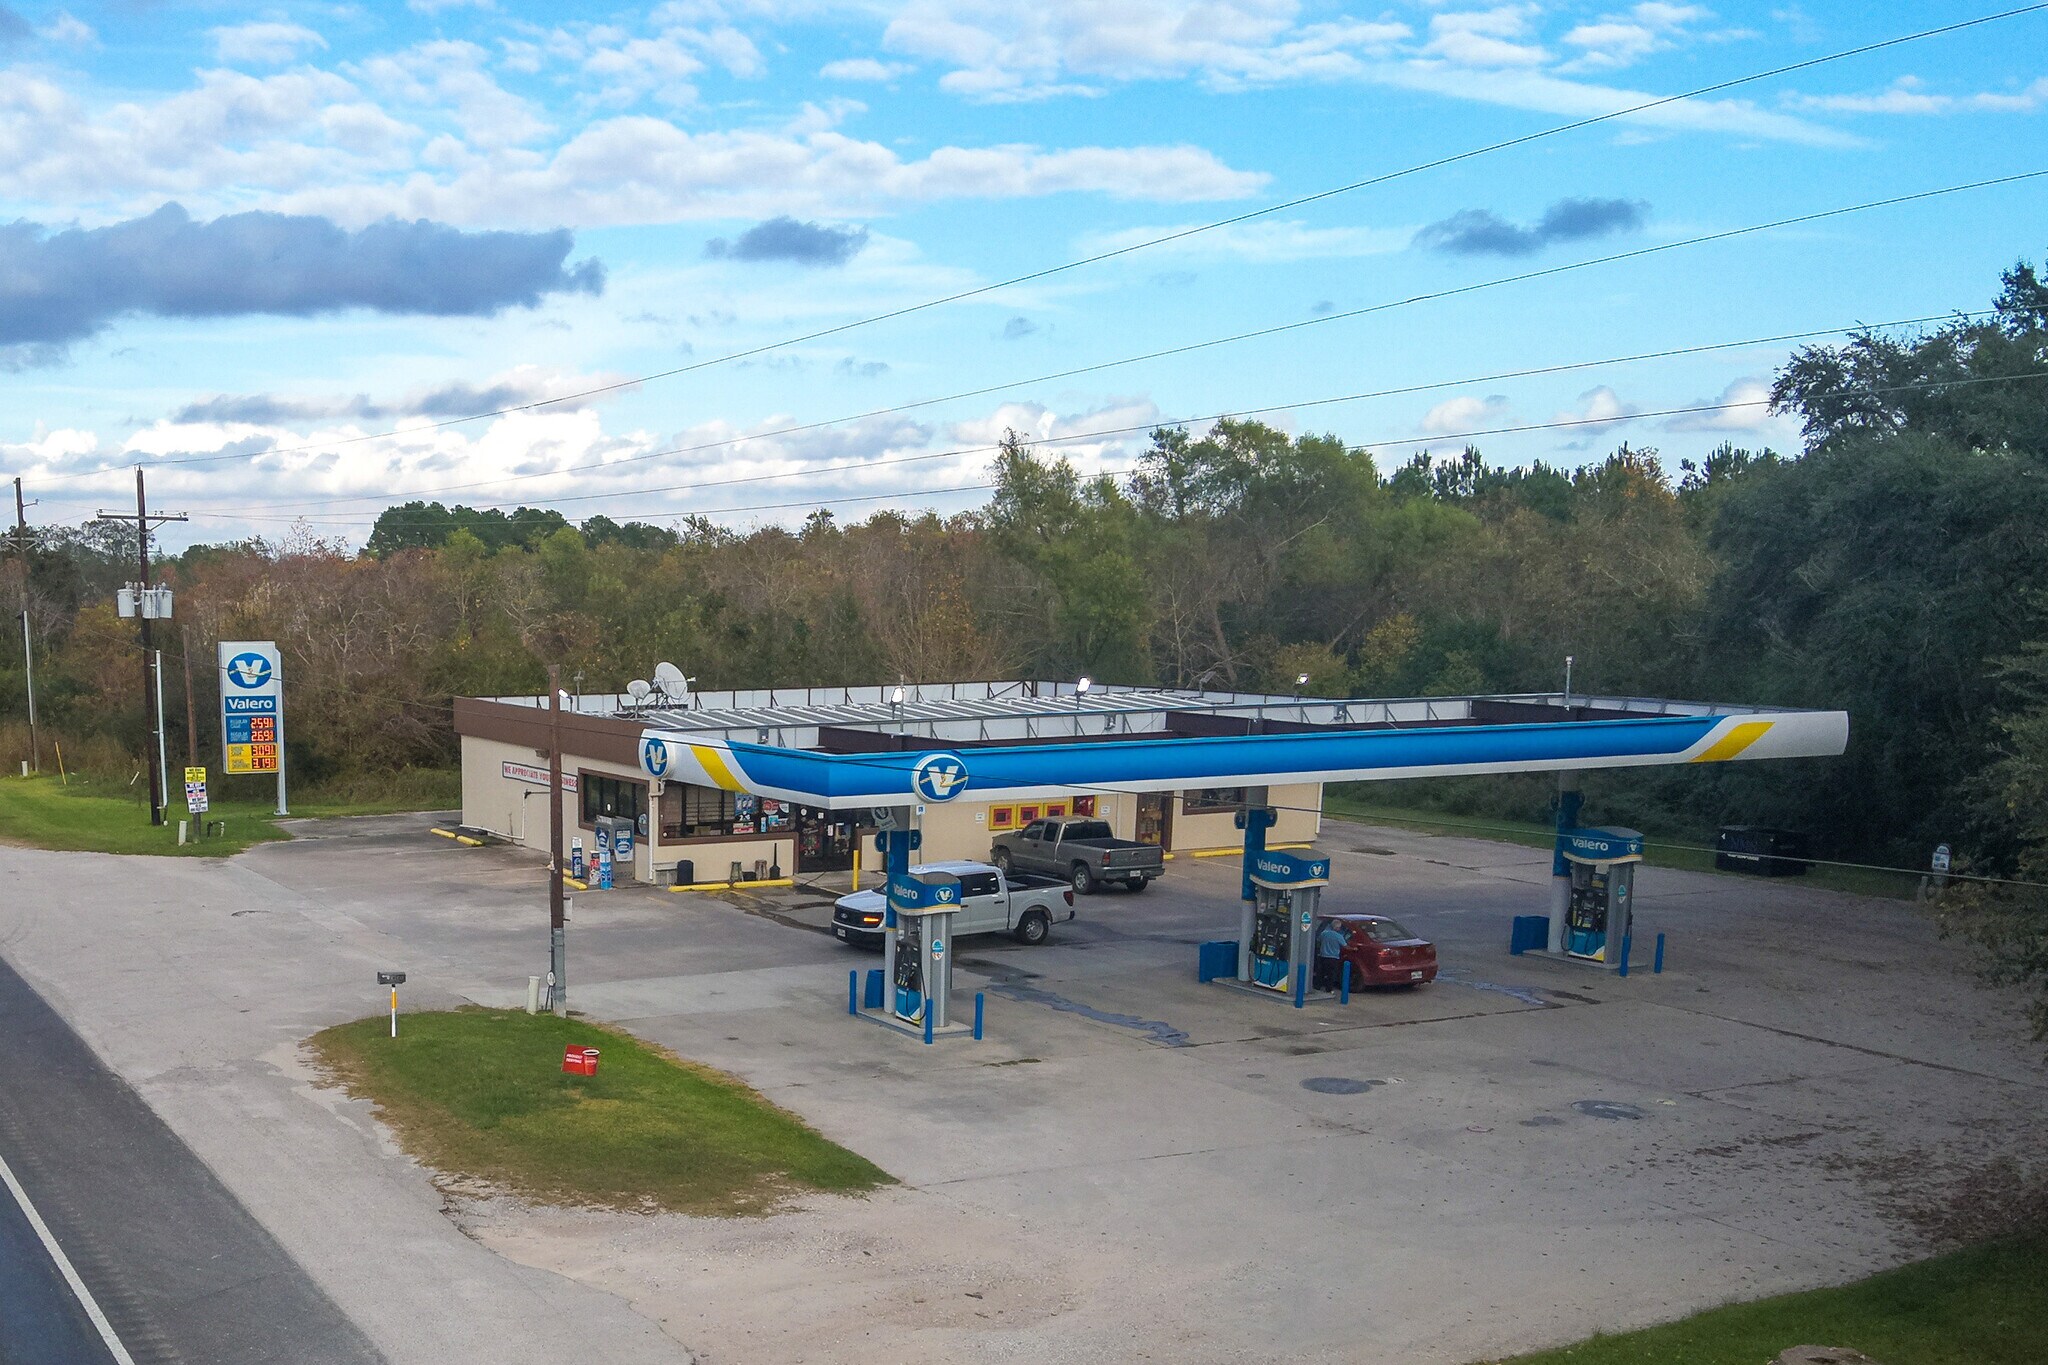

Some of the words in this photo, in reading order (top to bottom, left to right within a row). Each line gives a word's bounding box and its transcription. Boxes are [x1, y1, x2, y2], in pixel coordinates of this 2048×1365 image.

[228, 698, 273, 710] Valero
[1572, 838, 1609, 851] Valero
[1257, 859, 1290, 875] Valero
